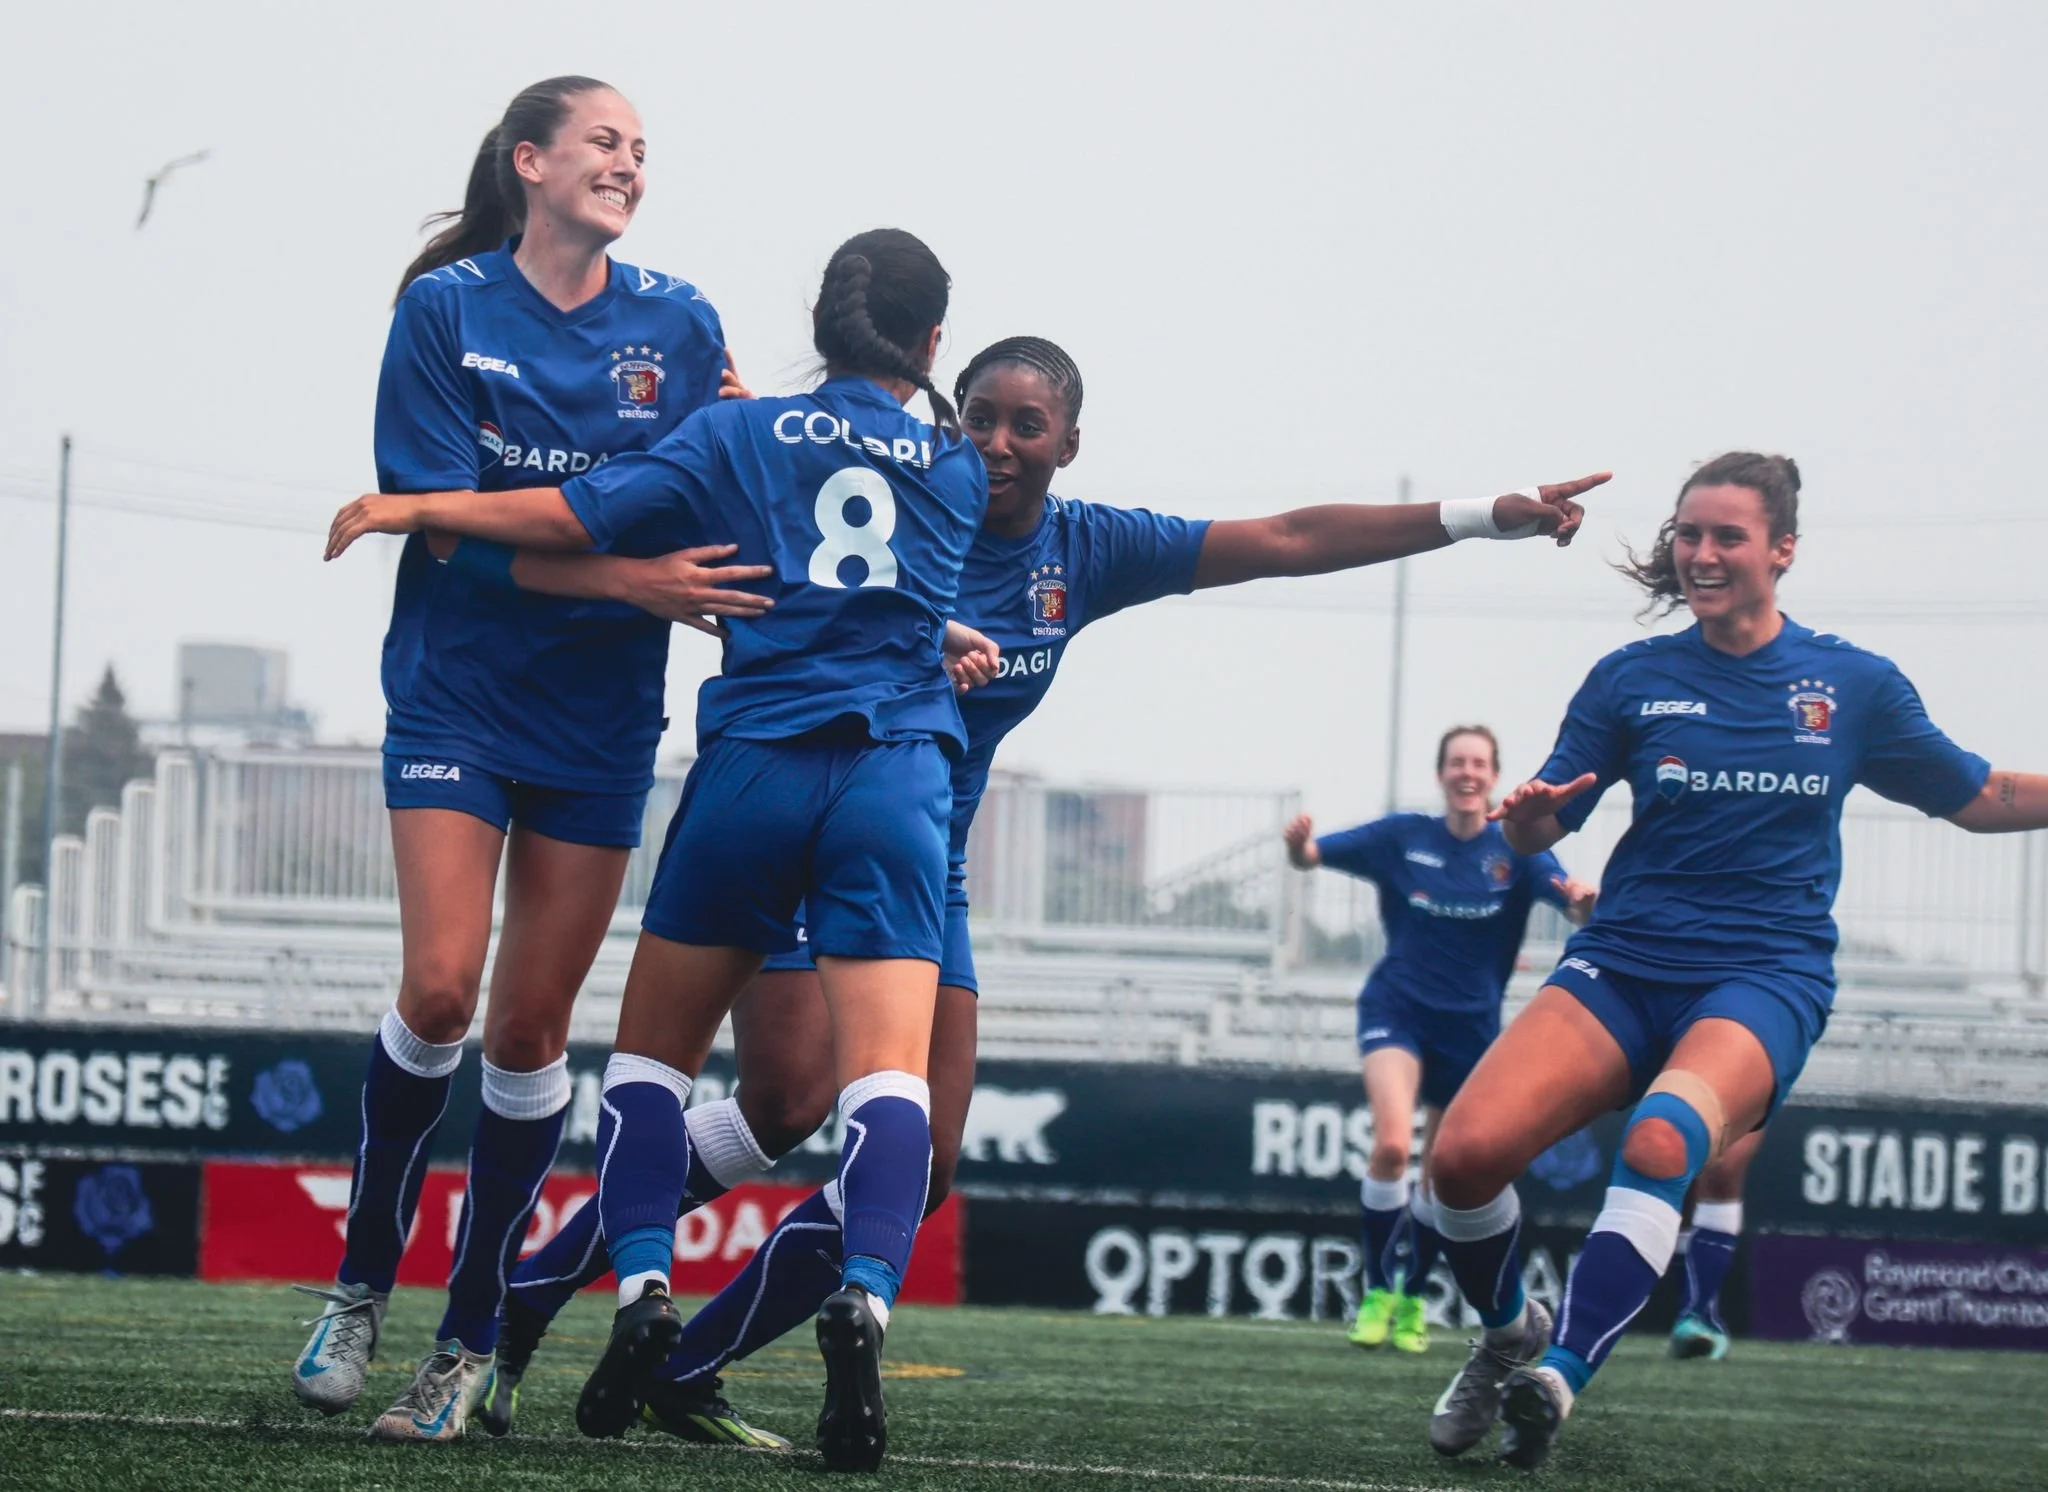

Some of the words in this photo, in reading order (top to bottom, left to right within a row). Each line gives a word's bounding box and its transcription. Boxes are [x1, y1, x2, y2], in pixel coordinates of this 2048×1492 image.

[808, 466, 898, 589] 8
[1640, 701, 1706, 715] LEGEA
[401, 764, 460, 781] LEGEA
[1691, 771, 1829, 795] BARDAGI
[0, 1049, 204, 1130] ROSES
[1803, 1129, 1986, 1213] STADE
[2001, 1140, 2048, 1215] B
[1864, 1251, 1997, 1292] Raymond
